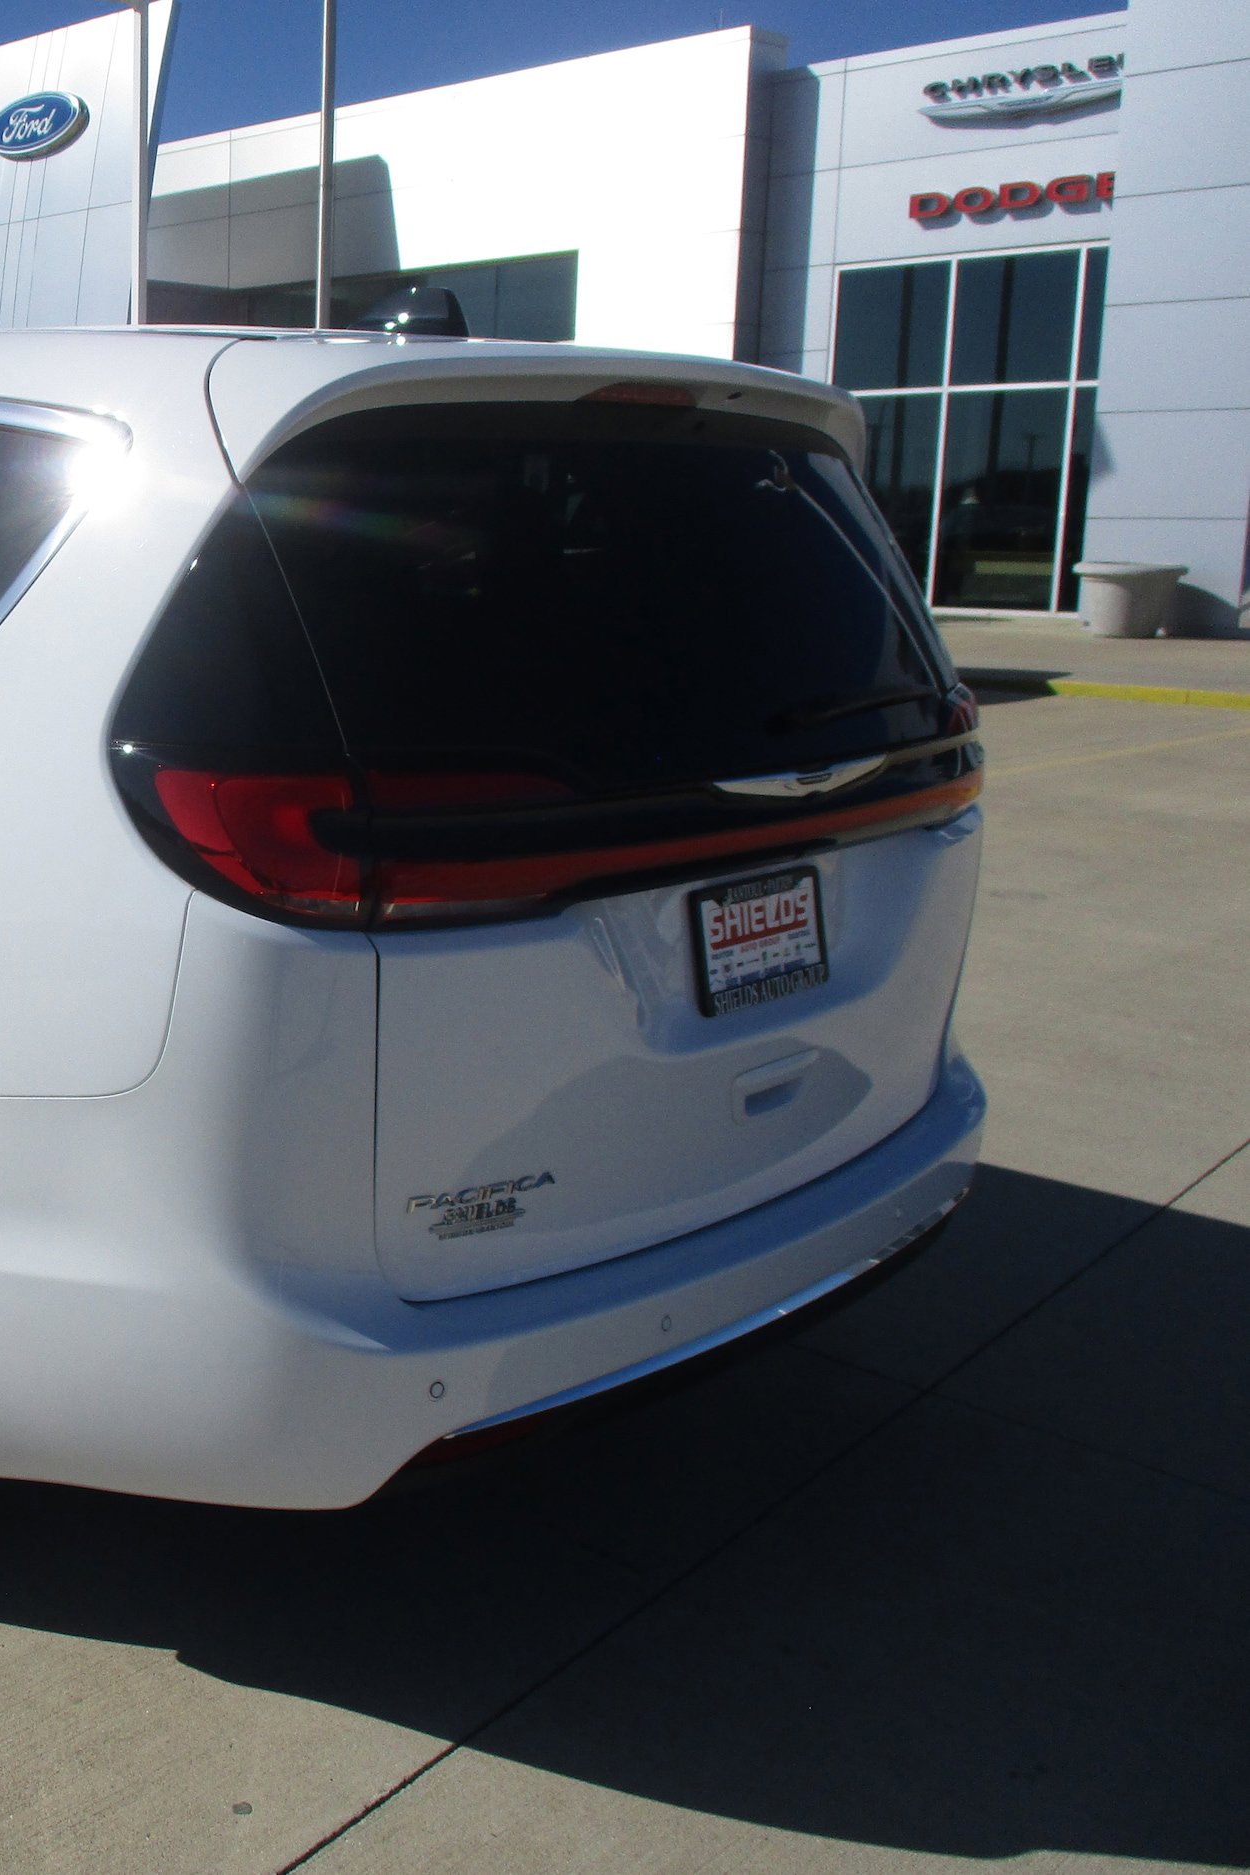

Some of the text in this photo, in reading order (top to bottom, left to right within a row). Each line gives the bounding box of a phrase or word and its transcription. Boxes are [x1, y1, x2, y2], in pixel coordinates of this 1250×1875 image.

[923, 52, 1125, 103] CHRYSLE
[2, 103, 57, 143] Ford
[709, 889, 808, 943] SHIELDS
[714, 983, 759, 1016] SHIELDS
[759, 972, 790, 1003] AUTO
[406, 1172, 555, 1214] PACIFICA
